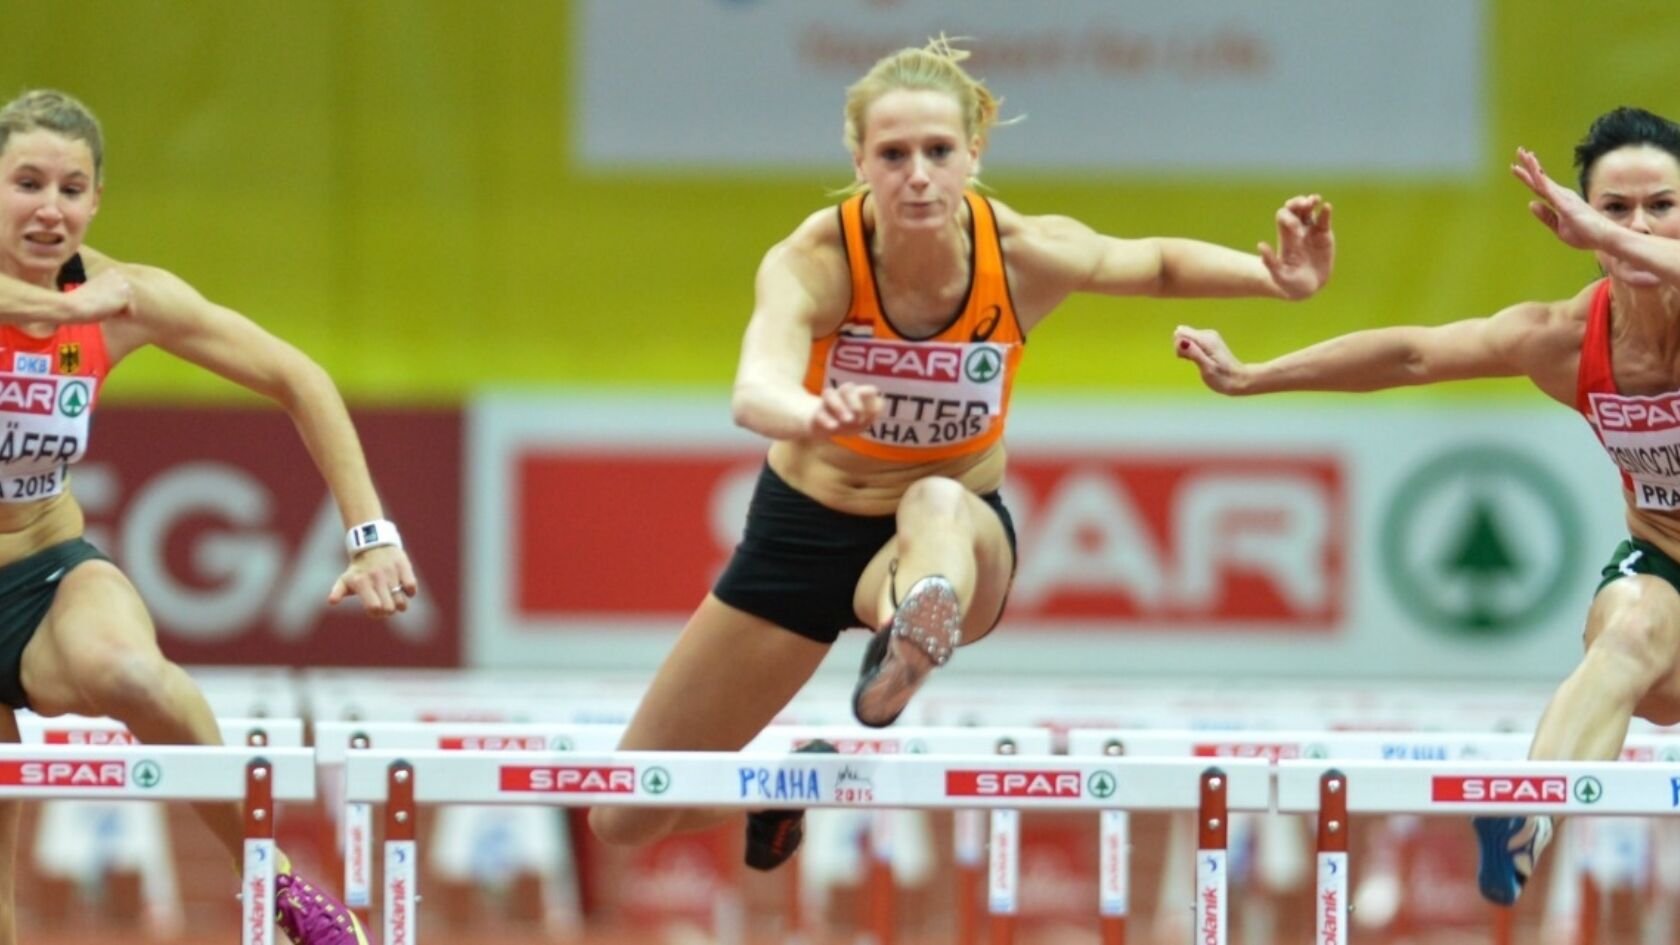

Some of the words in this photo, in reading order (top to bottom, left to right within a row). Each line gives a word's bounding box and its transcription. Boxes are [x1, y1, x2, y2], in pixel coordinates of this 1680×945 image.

[835, 345, 958, 378] SPAR
[928, 416, 982, 444] 2015
[13, 473, 55, 498] 2015
[20, 762, 124, 784] SPAR
[529, 769, 634, 790] SPAR
[739, 767, 820, 800] PRAHA
[976, 773, 1081, 794] SPAR
[834, 788, 874, 801] 2015
[1462, 779, 1566, 800] SPAR
